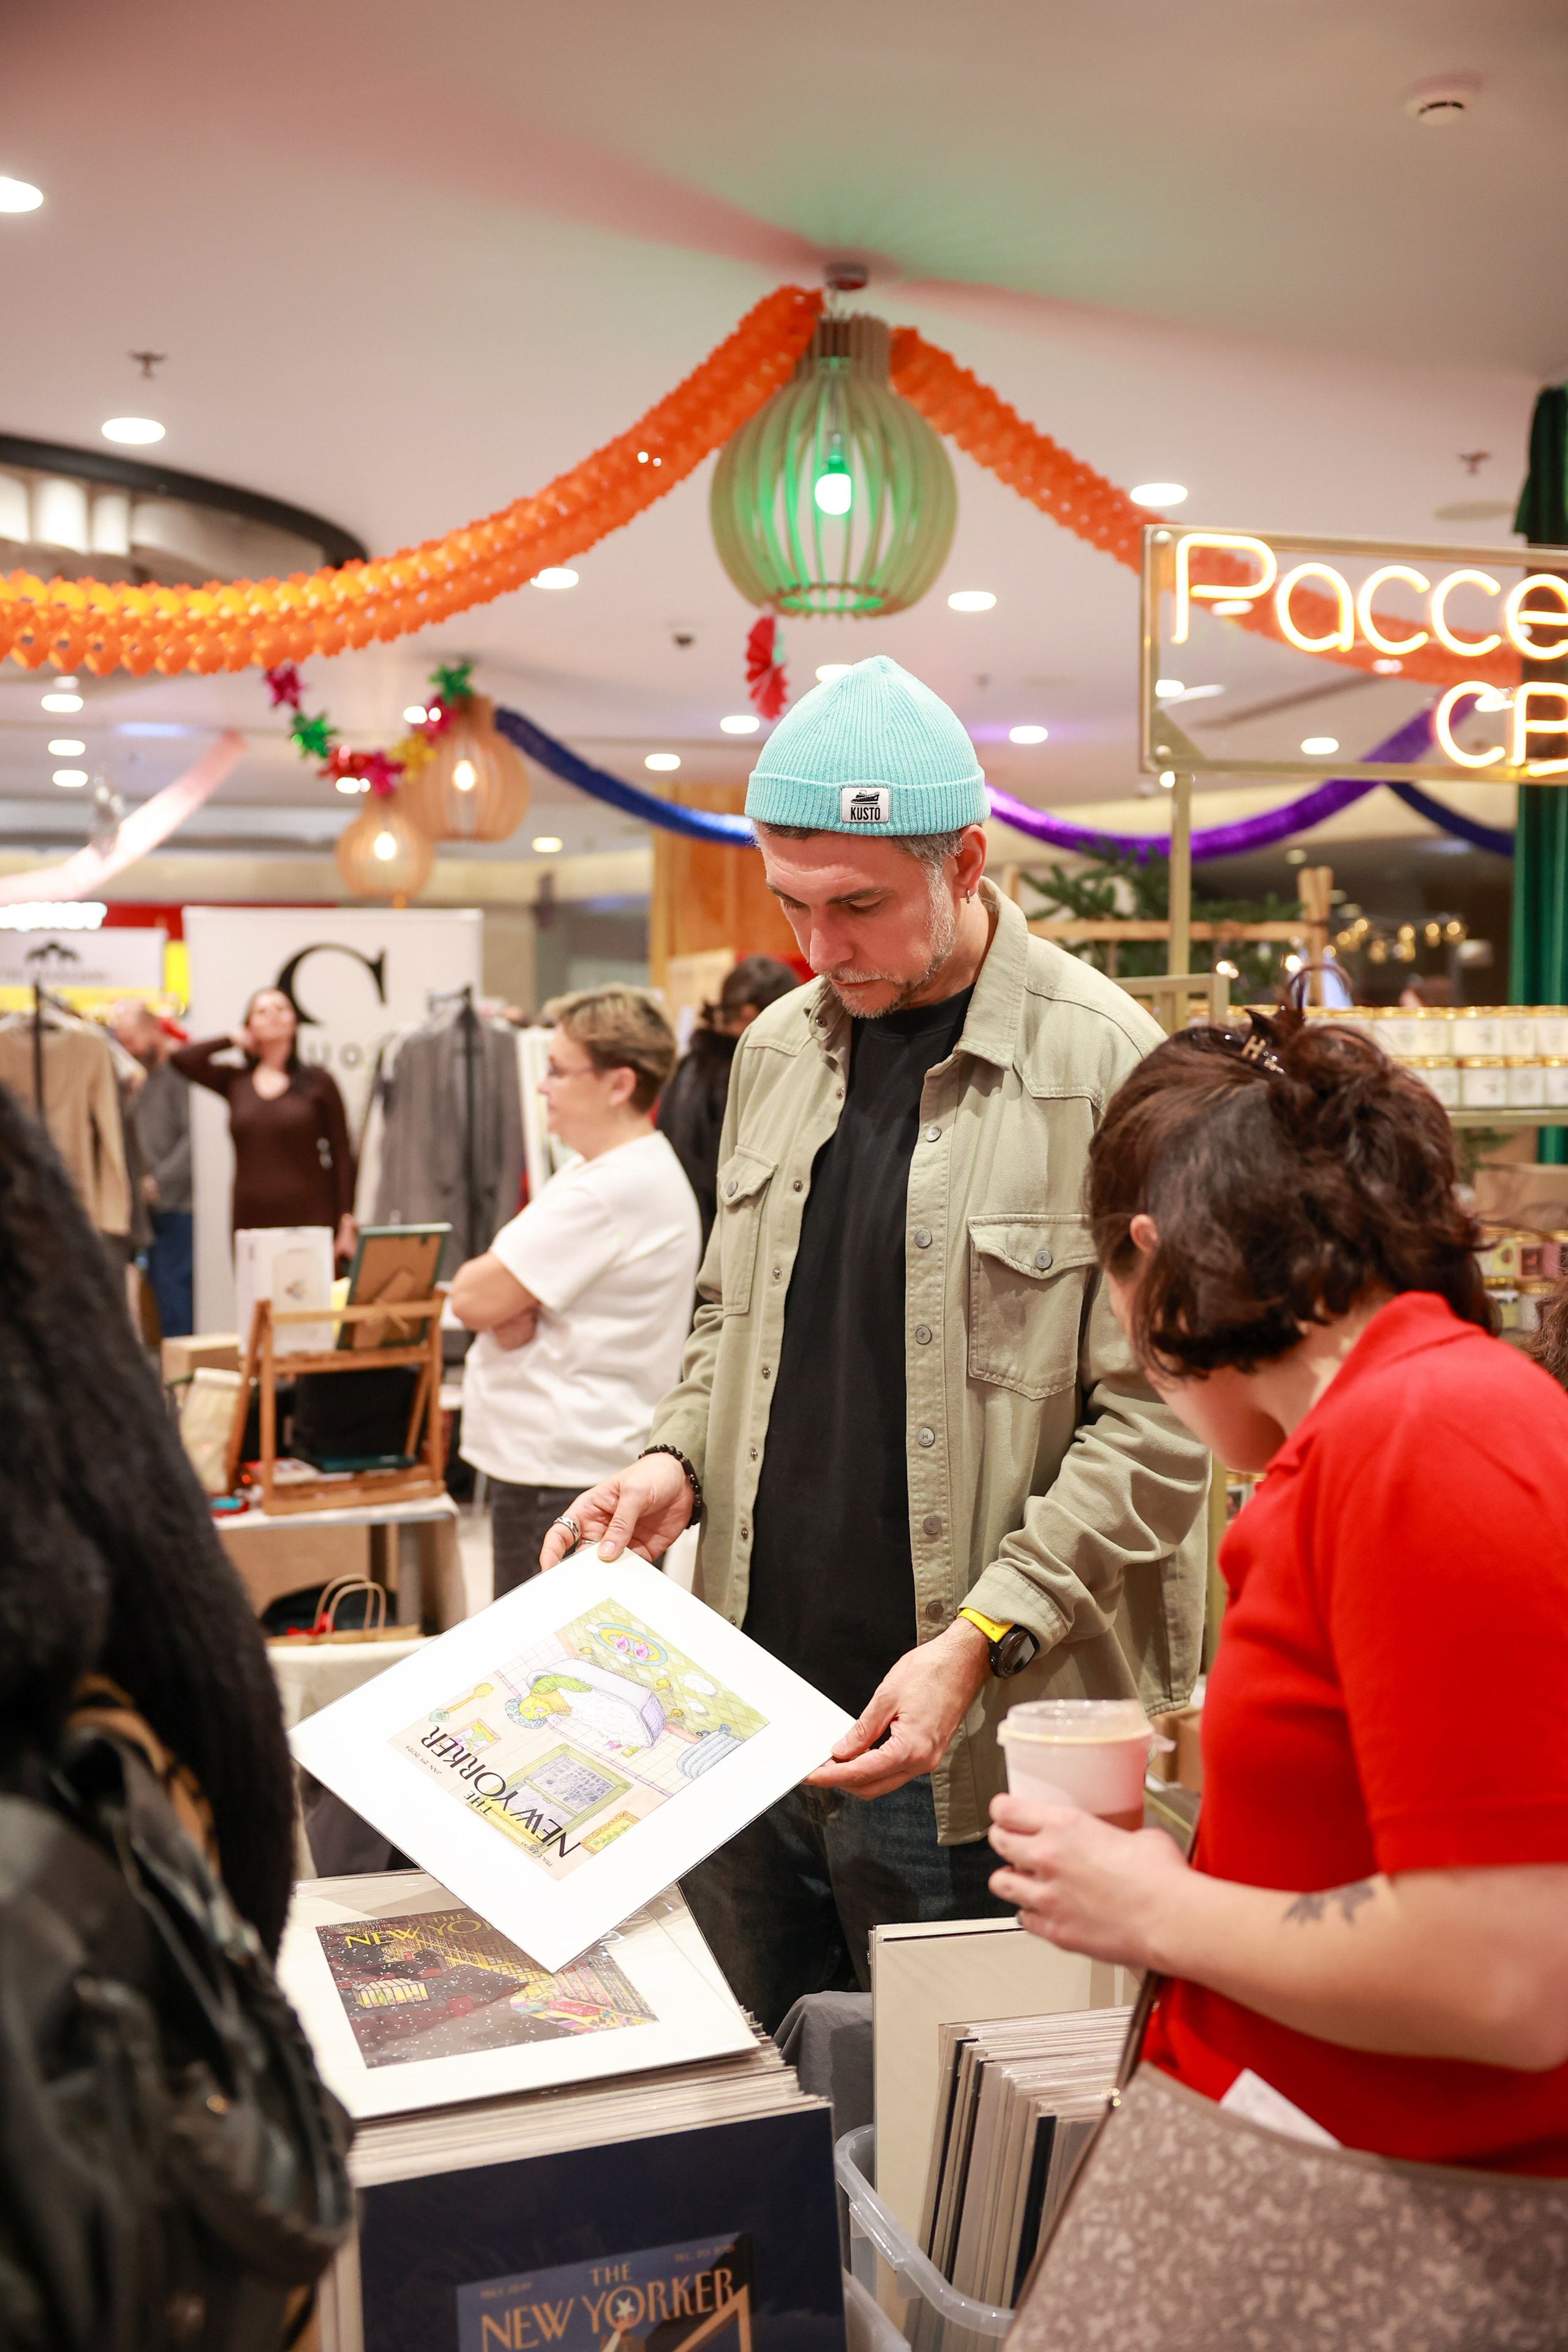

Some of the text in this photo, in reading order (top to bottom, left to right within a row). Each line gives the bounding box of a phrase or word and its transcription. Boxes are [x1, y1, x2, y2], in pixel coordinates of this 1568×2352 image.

[850, 807, 881, 821] KUSTO
[405, 1745, 420, 1758] 2024
[421, 1725, 581, 1858] NEW YORKER
[464, 1790, 492, 1816] THE
[537, 1853, 553, 1867] PRICE
[431, 1913, 466, 1923] THE
[345, 1920, 492, 1948] NEW YO
[589, 2261, 631, 2287] THE
[481, 2267, 734, 2352] NEW YORKER
